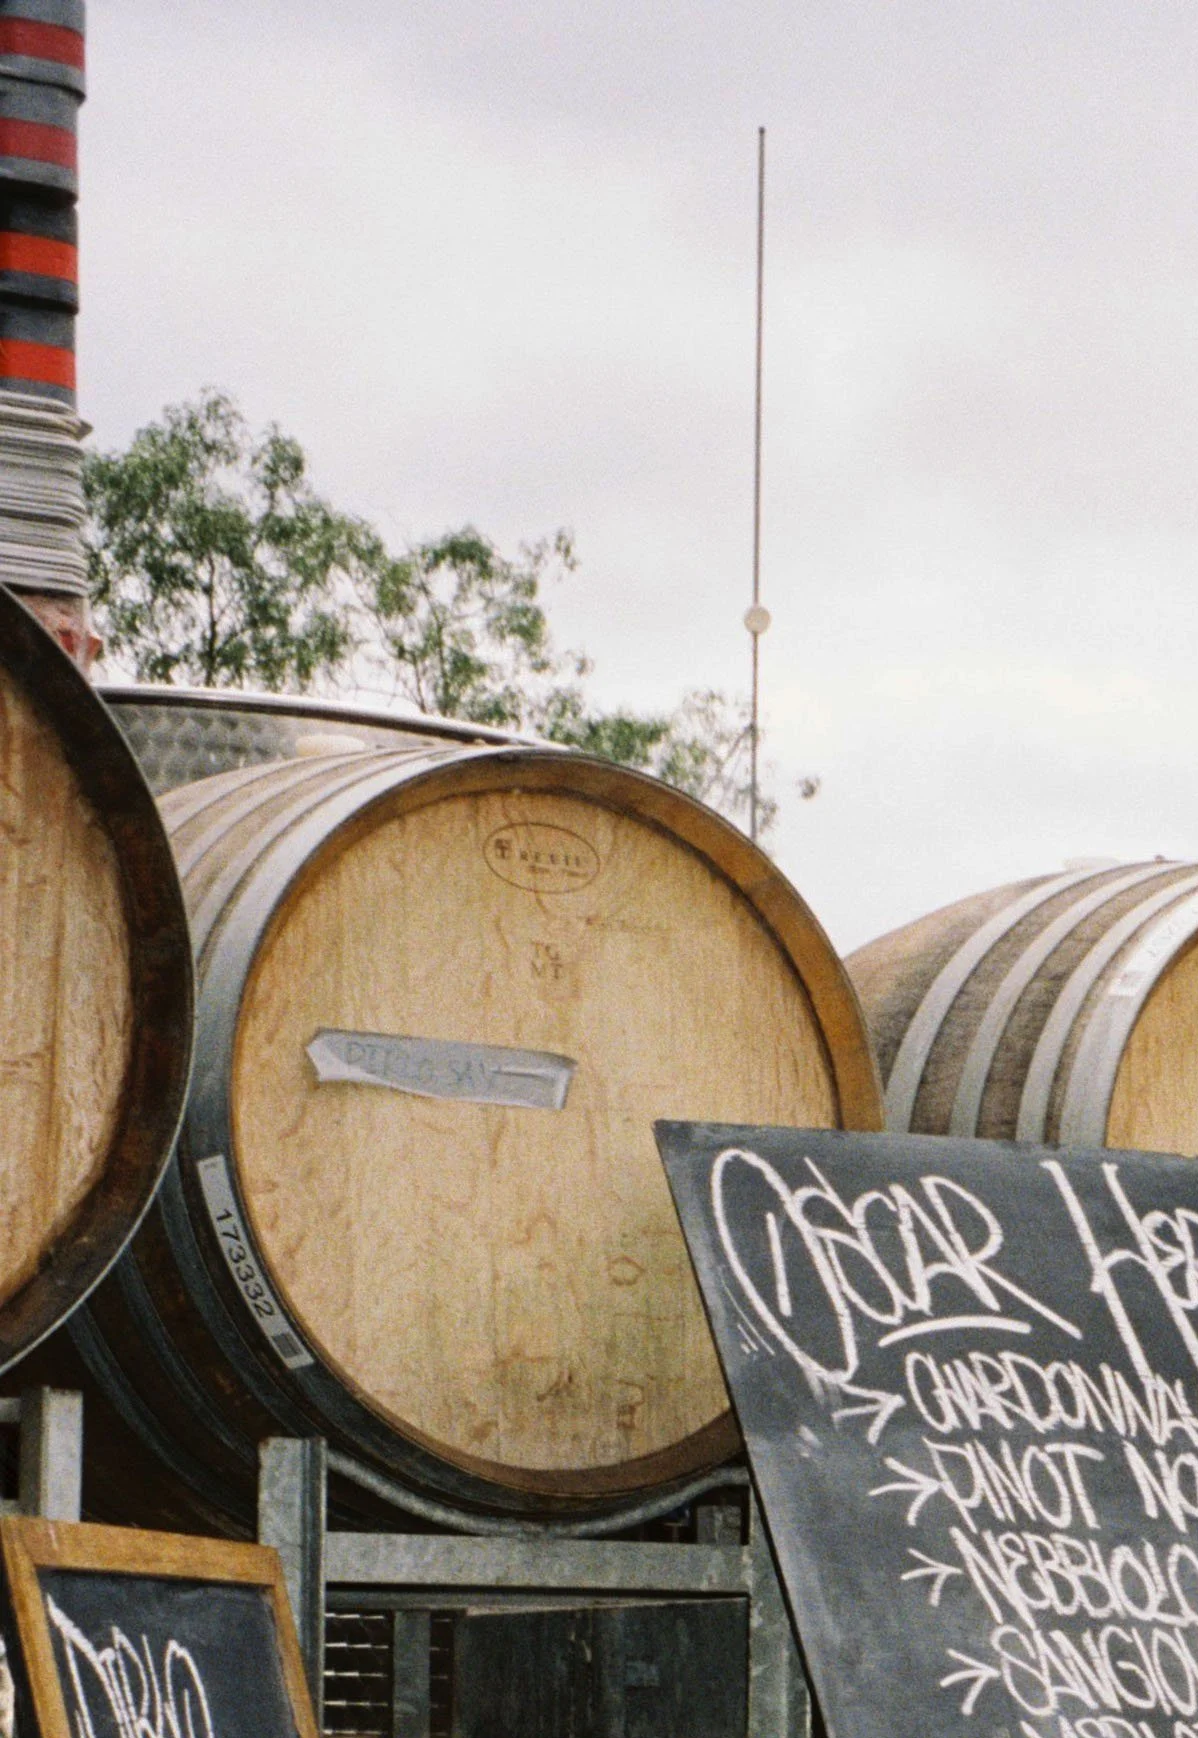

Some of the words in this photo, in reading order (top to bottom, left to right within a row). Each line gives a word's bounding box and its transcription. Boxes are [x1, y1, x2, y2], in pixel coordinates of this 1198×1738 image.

[216, 1208, 275, 1318] 173332
[712, 1147, 1083, 1384] OSCAR
[922, 1438, 1105, 1530] PINOT
